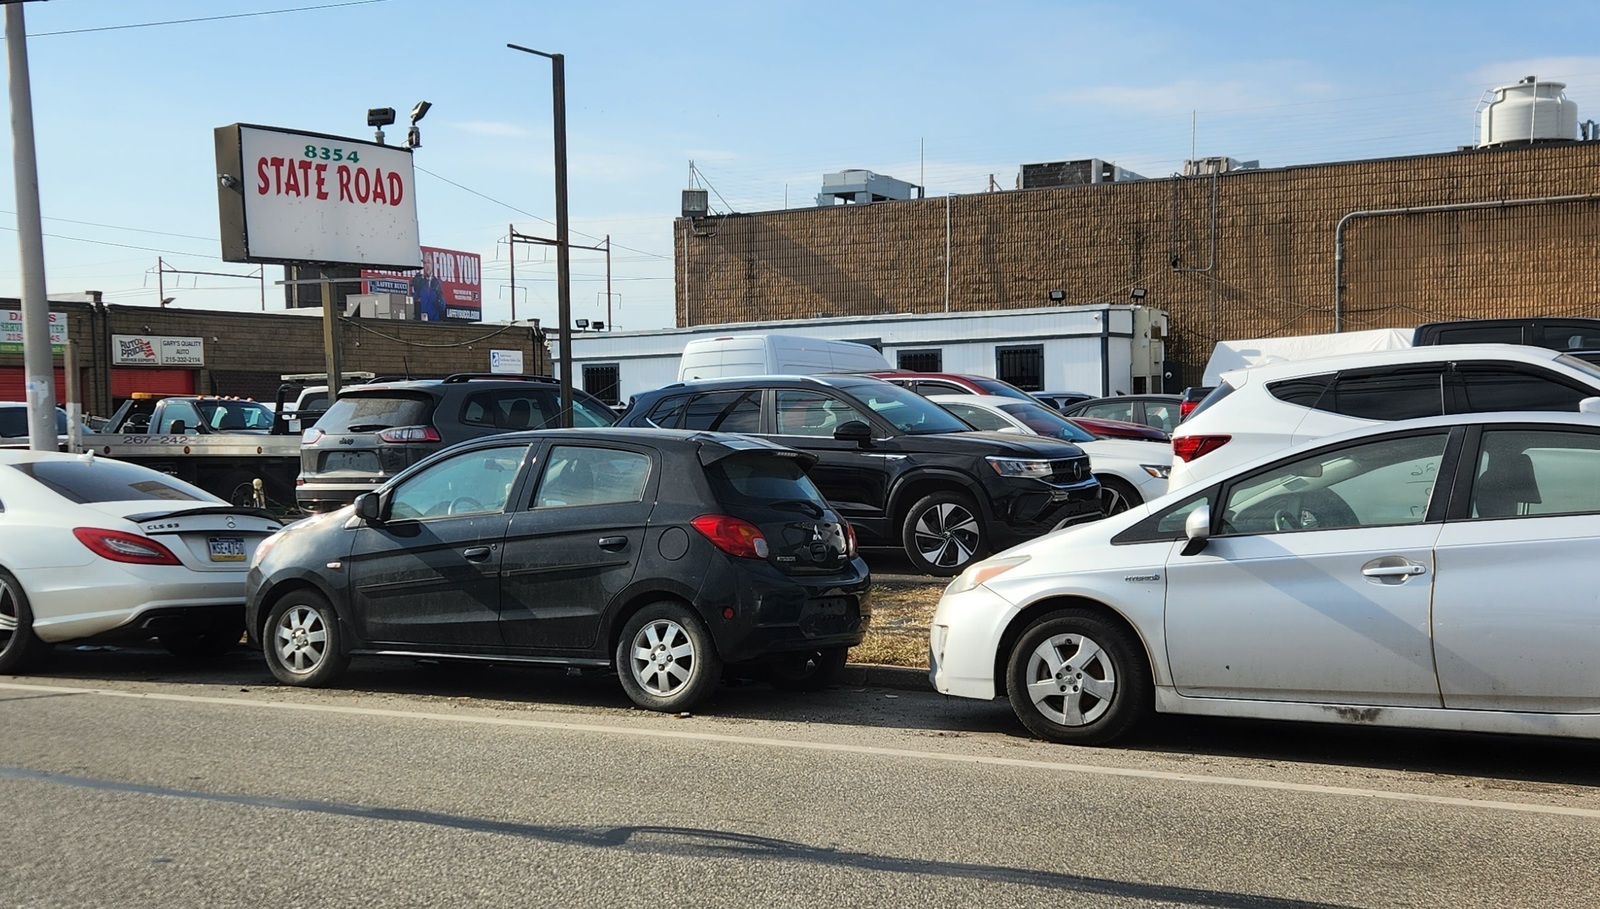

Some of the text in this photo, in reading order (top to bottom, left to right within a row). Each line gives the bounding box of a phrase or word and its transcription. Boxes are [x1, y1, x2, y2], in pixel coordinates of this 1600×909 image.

[304, 145, 360, 164] 8354
[257, 156, 404, 207] STATE ROAD
[433, 251, 480, 286] FOR YOU
[119, 338, 142, 350] AUTO
[121, 345, 145, 358] PRIDE
